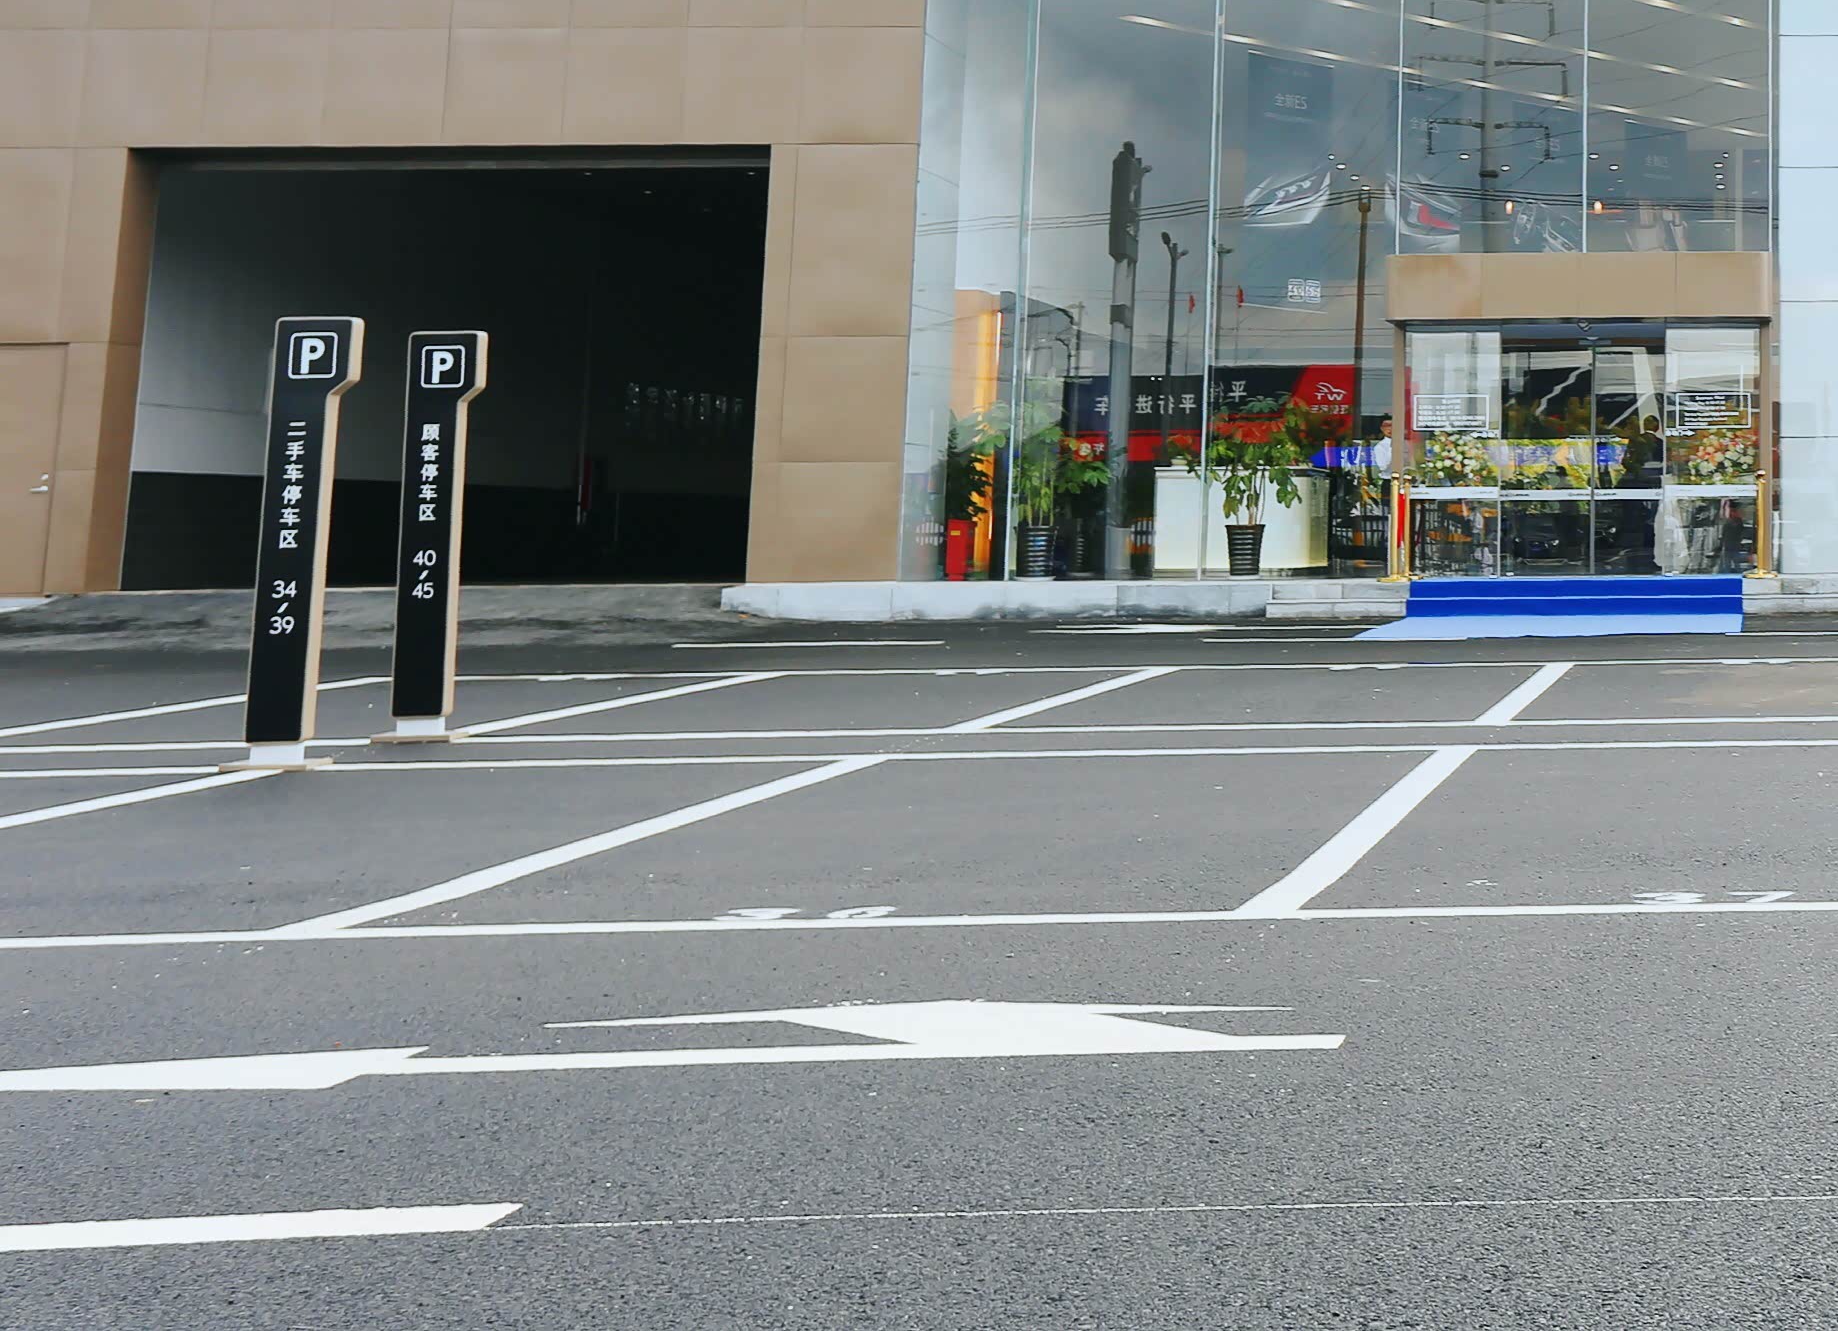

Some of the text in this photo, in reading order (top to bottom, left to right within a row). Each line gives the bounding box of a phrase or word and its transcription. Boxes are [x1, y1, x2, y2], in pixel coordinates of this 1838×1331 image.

[300, 337, 326, 374] P
[431, 351, 454, 384] P
[279, 421, 306, 549] 二手车停车区
[418, 423, 440, 522] 顾客停车区
[412, 549, 437, 566] 40
[271, 580, 298, 599] 34
[411, 581, 434, 600] 45
[268, 616, 295, 636] 39
